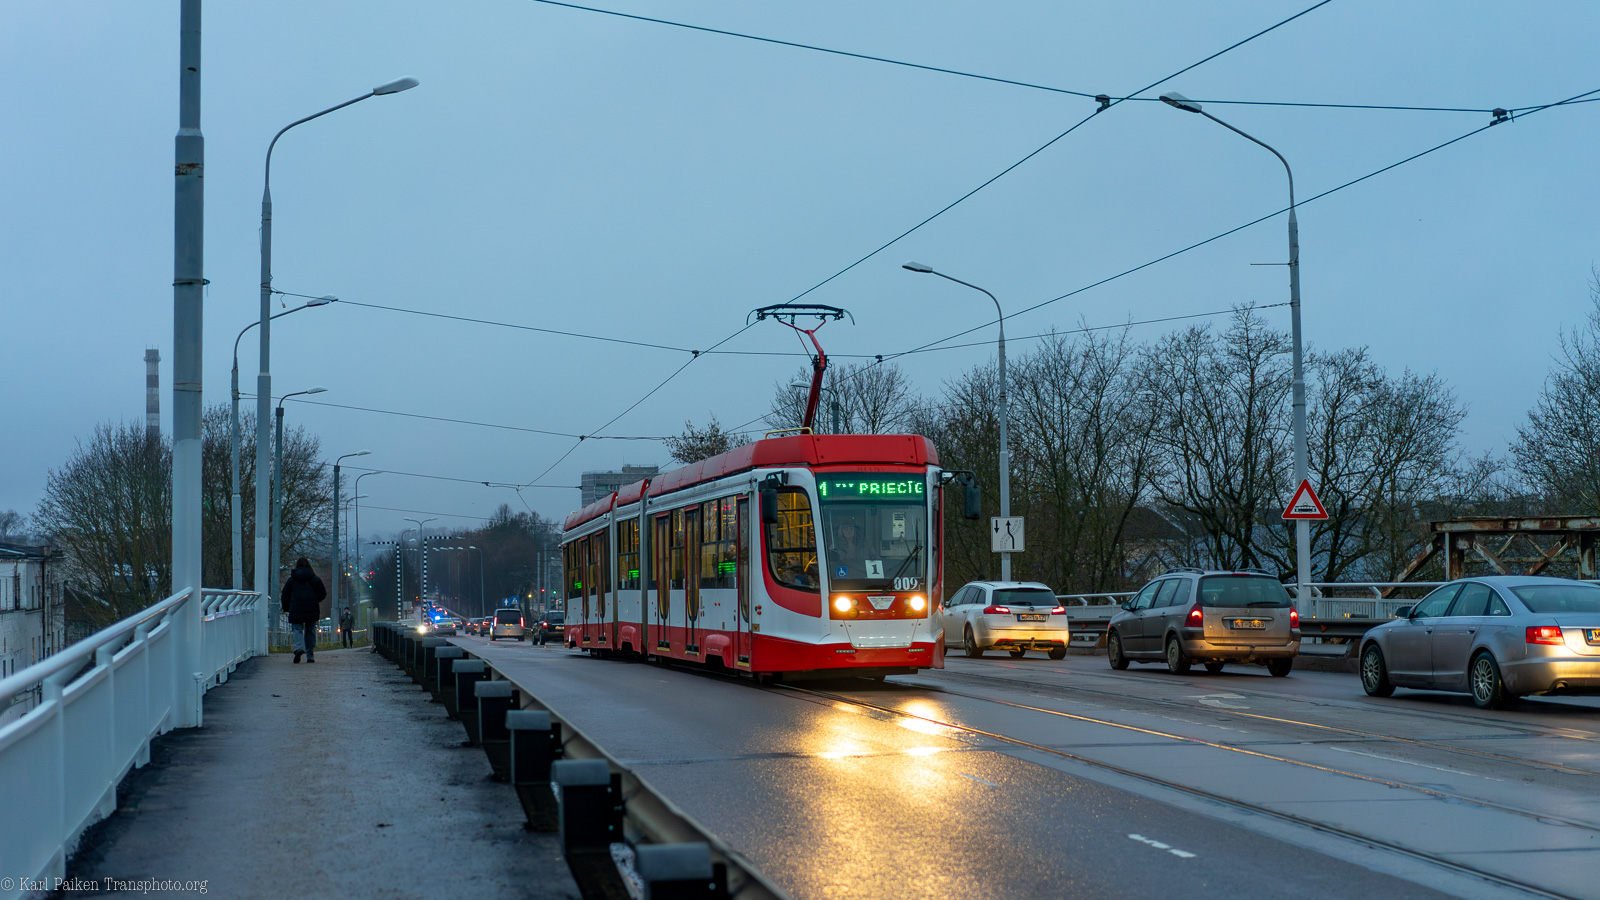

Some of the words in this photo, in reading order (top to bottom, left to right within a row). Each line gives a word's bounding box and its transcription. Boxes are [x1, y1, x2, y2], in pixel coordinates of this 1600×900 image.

[819, 481, 827, 496] 1
[871, 564, 880, 575] 1
[893, 576, 918, 590] 009
